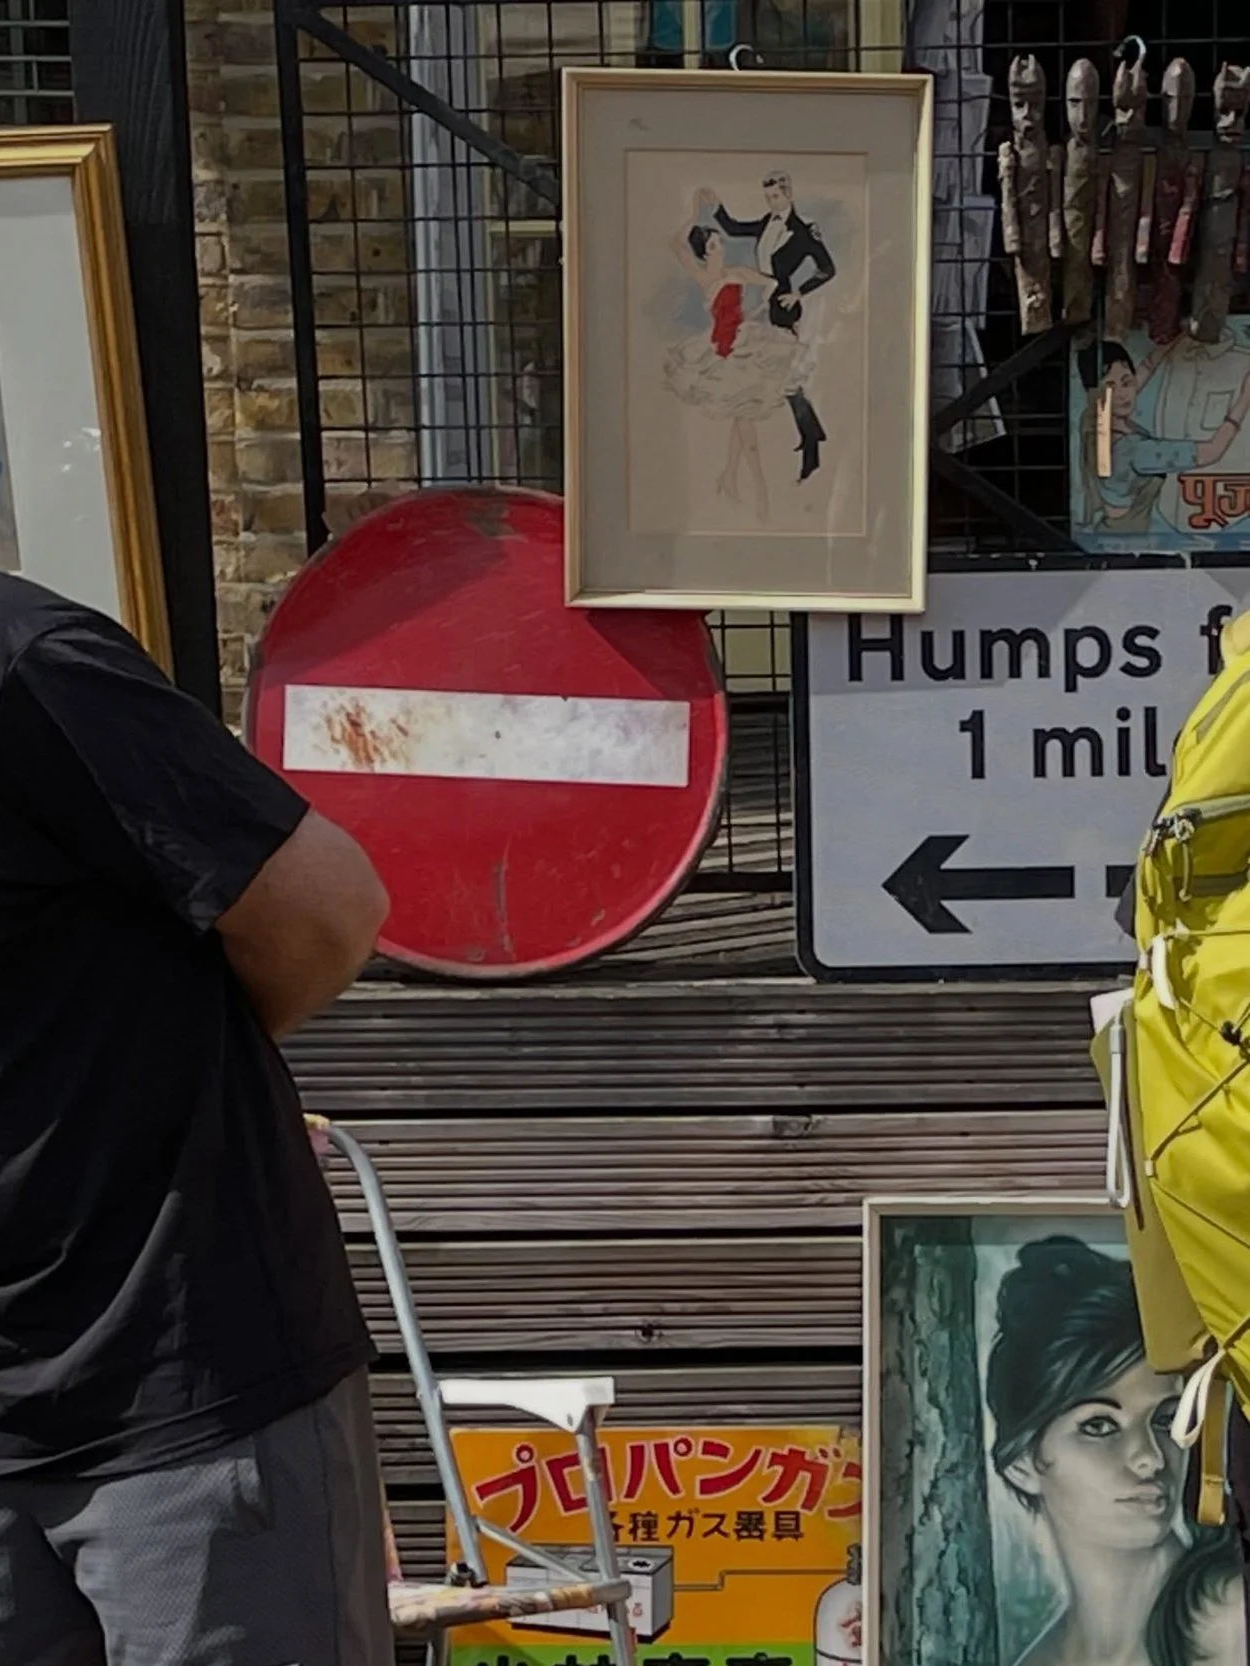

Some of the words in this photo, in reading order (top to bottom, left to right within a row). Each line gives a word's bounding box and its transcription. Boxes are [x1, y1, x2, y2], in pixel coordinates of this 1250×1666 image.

[848, 614, 1162, 692] Humps
[1200, 605, 1233, 675] f
[959, 710, 986, 779] 1
[1032, 706, 1166, 778] mil
